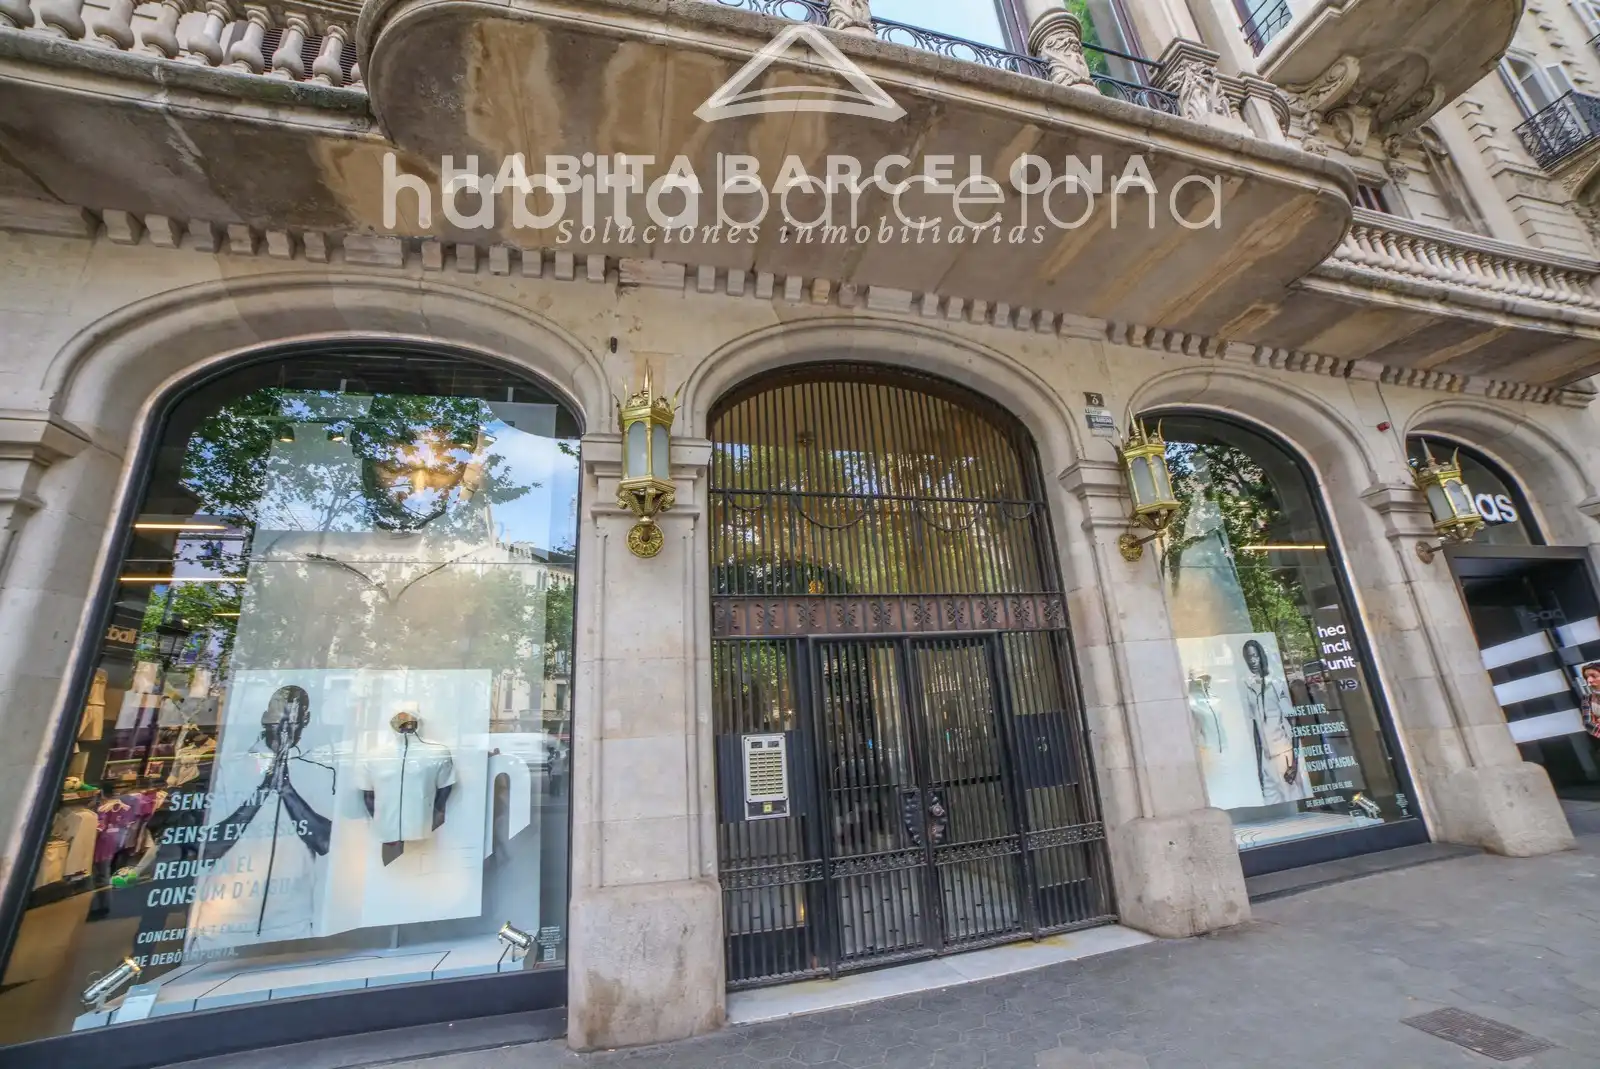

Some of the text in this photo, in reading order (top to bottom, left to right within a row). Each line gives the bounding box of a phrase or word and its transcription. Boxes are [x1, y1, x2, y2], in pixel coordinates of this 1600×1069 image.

[1317, 624, 1347, 638] hea
[169, 791, 224, 811] SENS
[161, 820, 313, 844] SENSE EXESSOS.
[147, 881, 226, 907] CONSUM
